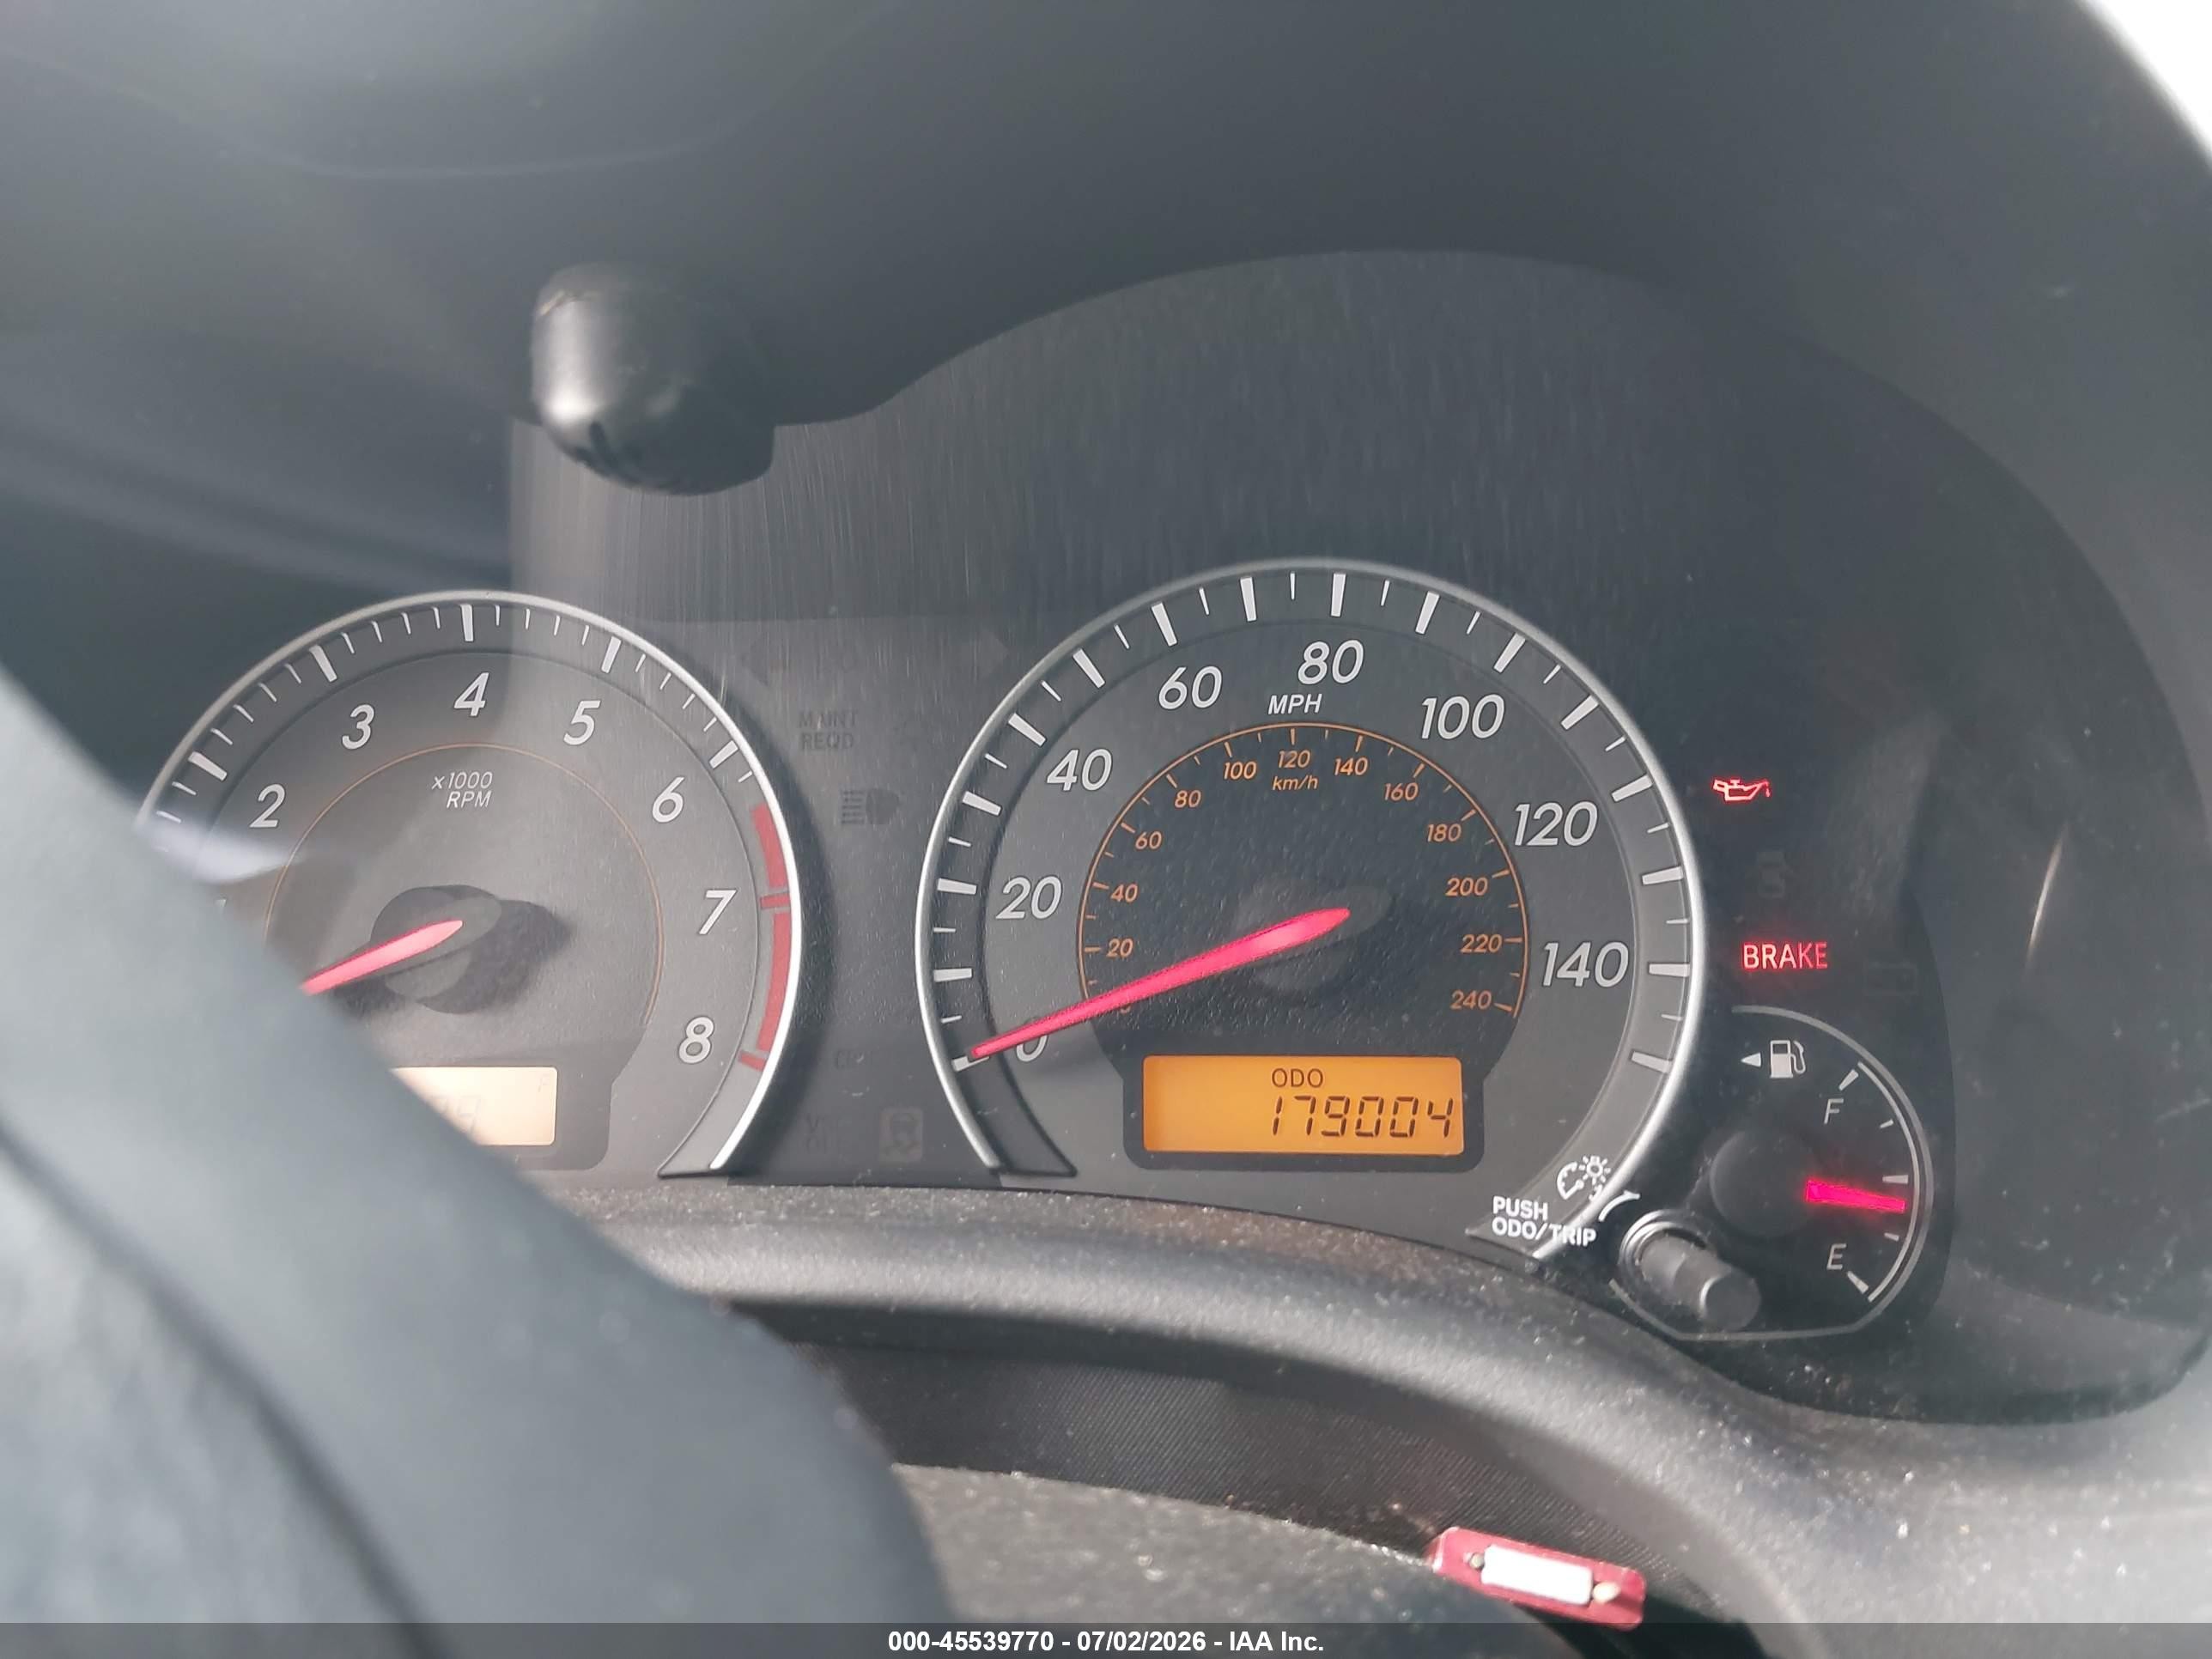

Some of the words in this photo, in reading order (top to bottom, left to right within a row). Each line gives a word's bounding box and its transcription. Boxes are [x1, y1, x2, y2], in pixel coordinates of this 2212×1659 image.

[1297, 640, 1364, 685] 80
[454, 672, 490, 716] 4
[1158, 666, 1223, 709] 60
[1267, 694, 1322, 714] MPH
[1421, 694, 1505, 739] 100
[343, 705, 374, 750] 3
[564, 701, 599, 744] 5
[1047, 749, 1112, 793] 40
[1223, 762, 1257, 780] 100
[1278, 750, 1310, 769] 120
[1334, 757, 1368, 775] 140
[1272, 775, 1318, 790] km/h
[1384, 782, 1419, 801] 160
[250, 785, 285, 828] 2
[447, 790, 491, 808] RPM
[652, 777, 684, 822] 6
[1174, 790, 1201, 808] 80
[1426, 823, 1461, 842] 180
[1514, 802, 1597, 848] 120
[1135, 831, 1162, 849] 60
[994, 876, 1061, 921] 20
[1110, 884, 1138, 902] 40
[1445, 878, 1487, 896] 200
[700, 890, 736, 935] 7
[1106, 939, 1133, 957] 20
[1461, 934, 1502, 953] 220
[1741, 943, 1827, 969] BRAKE
[1541, 941, 1630, 988] 140
[1449, 990, 1491, 1010] 240
[678, 1018, 714, 1064] 8
[1272, 1068, 1323, 1087] ODO
[1273, 1096, 1453, 1138] 179004
[1824, 1098, 1843, 1124] F
[1492, 1196, 1548, 1221] PUSH
[1492, 1216, 1596, 1246] ODO/TRIP
[1826, 1243, 1846, 1270] E
